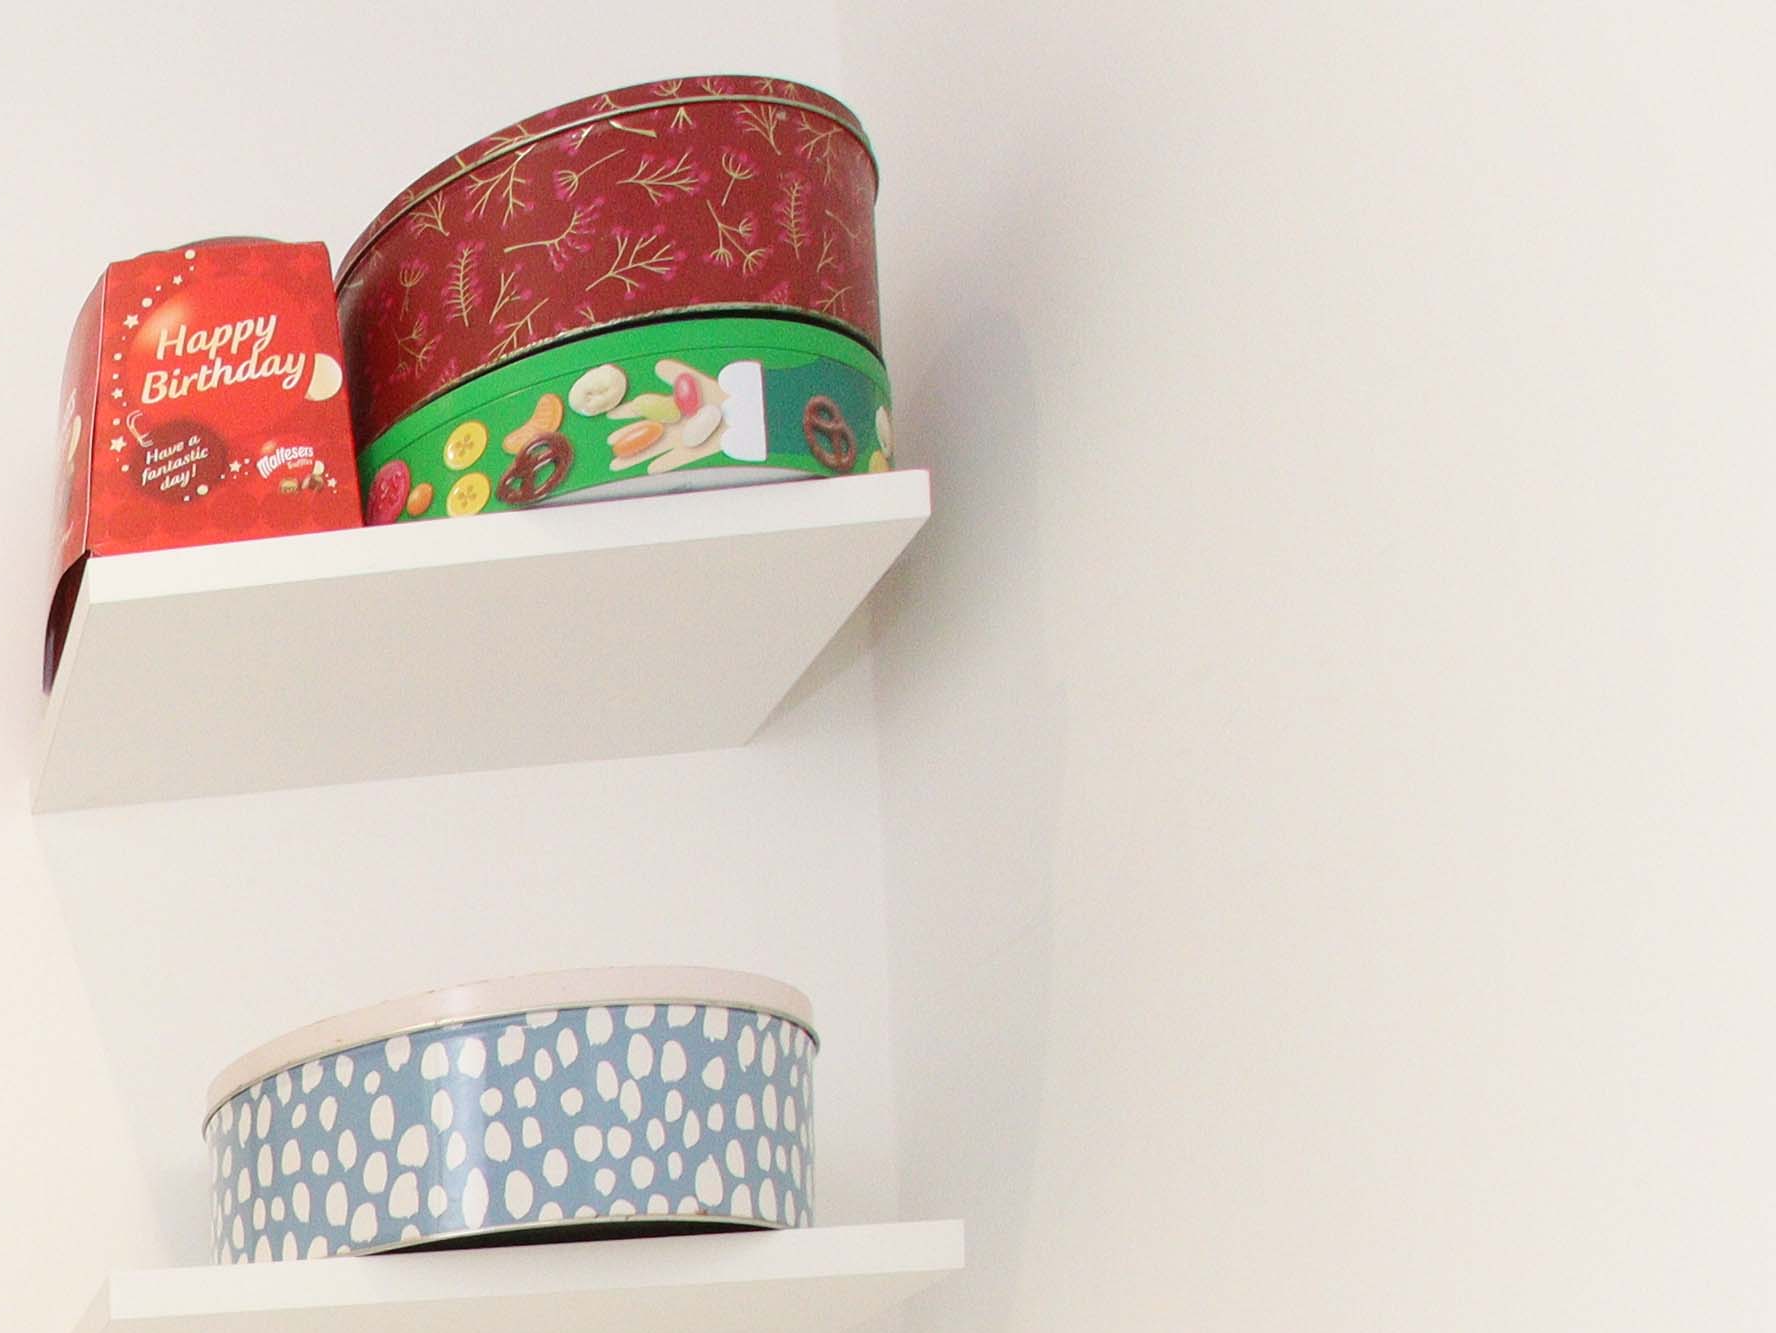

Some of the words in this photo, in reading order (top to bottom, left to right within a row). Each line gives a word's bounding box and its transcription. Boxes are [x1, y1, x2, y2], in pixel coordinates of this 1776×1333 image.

[156, 314, 277, 361] Happy
[141, 341, 306, 404] Birthday
[141, 447, 209, 487] fantastic
[146, 440, 184, 465] Have
[188, 435, 200, 445] a
[256, 446, 314, 480] Maltesers
[160, 463, 197, 492] day!
